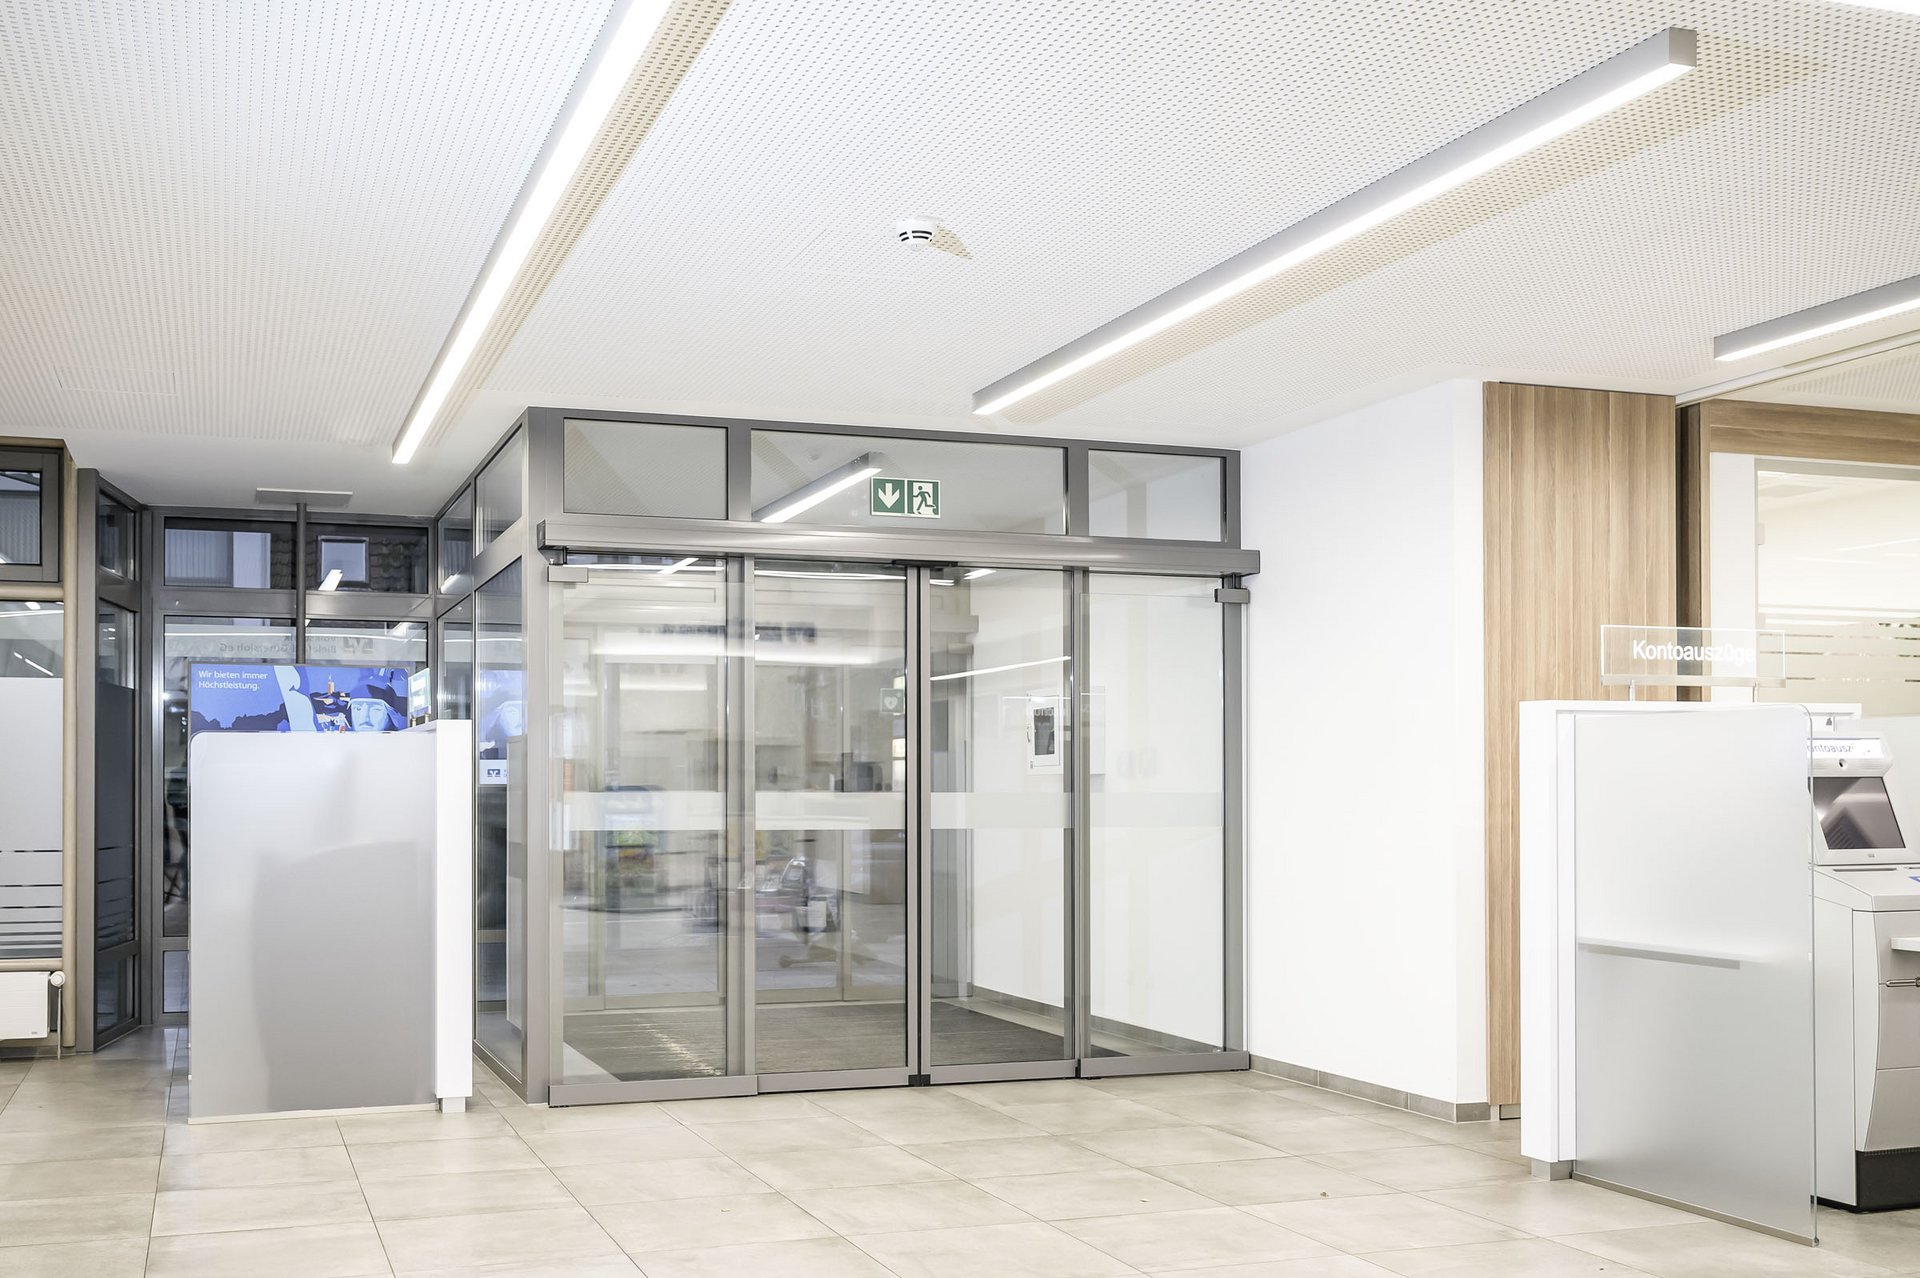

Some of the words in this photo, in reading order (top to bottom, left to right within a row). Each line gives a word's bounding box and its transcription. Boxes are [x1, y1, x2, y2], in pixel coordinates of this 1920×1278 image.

[1632, 640, 1755, 667] Kontoauszüge
[198, 670, 212, 678] Wir
[214, 670, 240, 679] bieten
[242, 671, 269, 679] immer
[198, 680, 260, 691] Höchstleistung.
